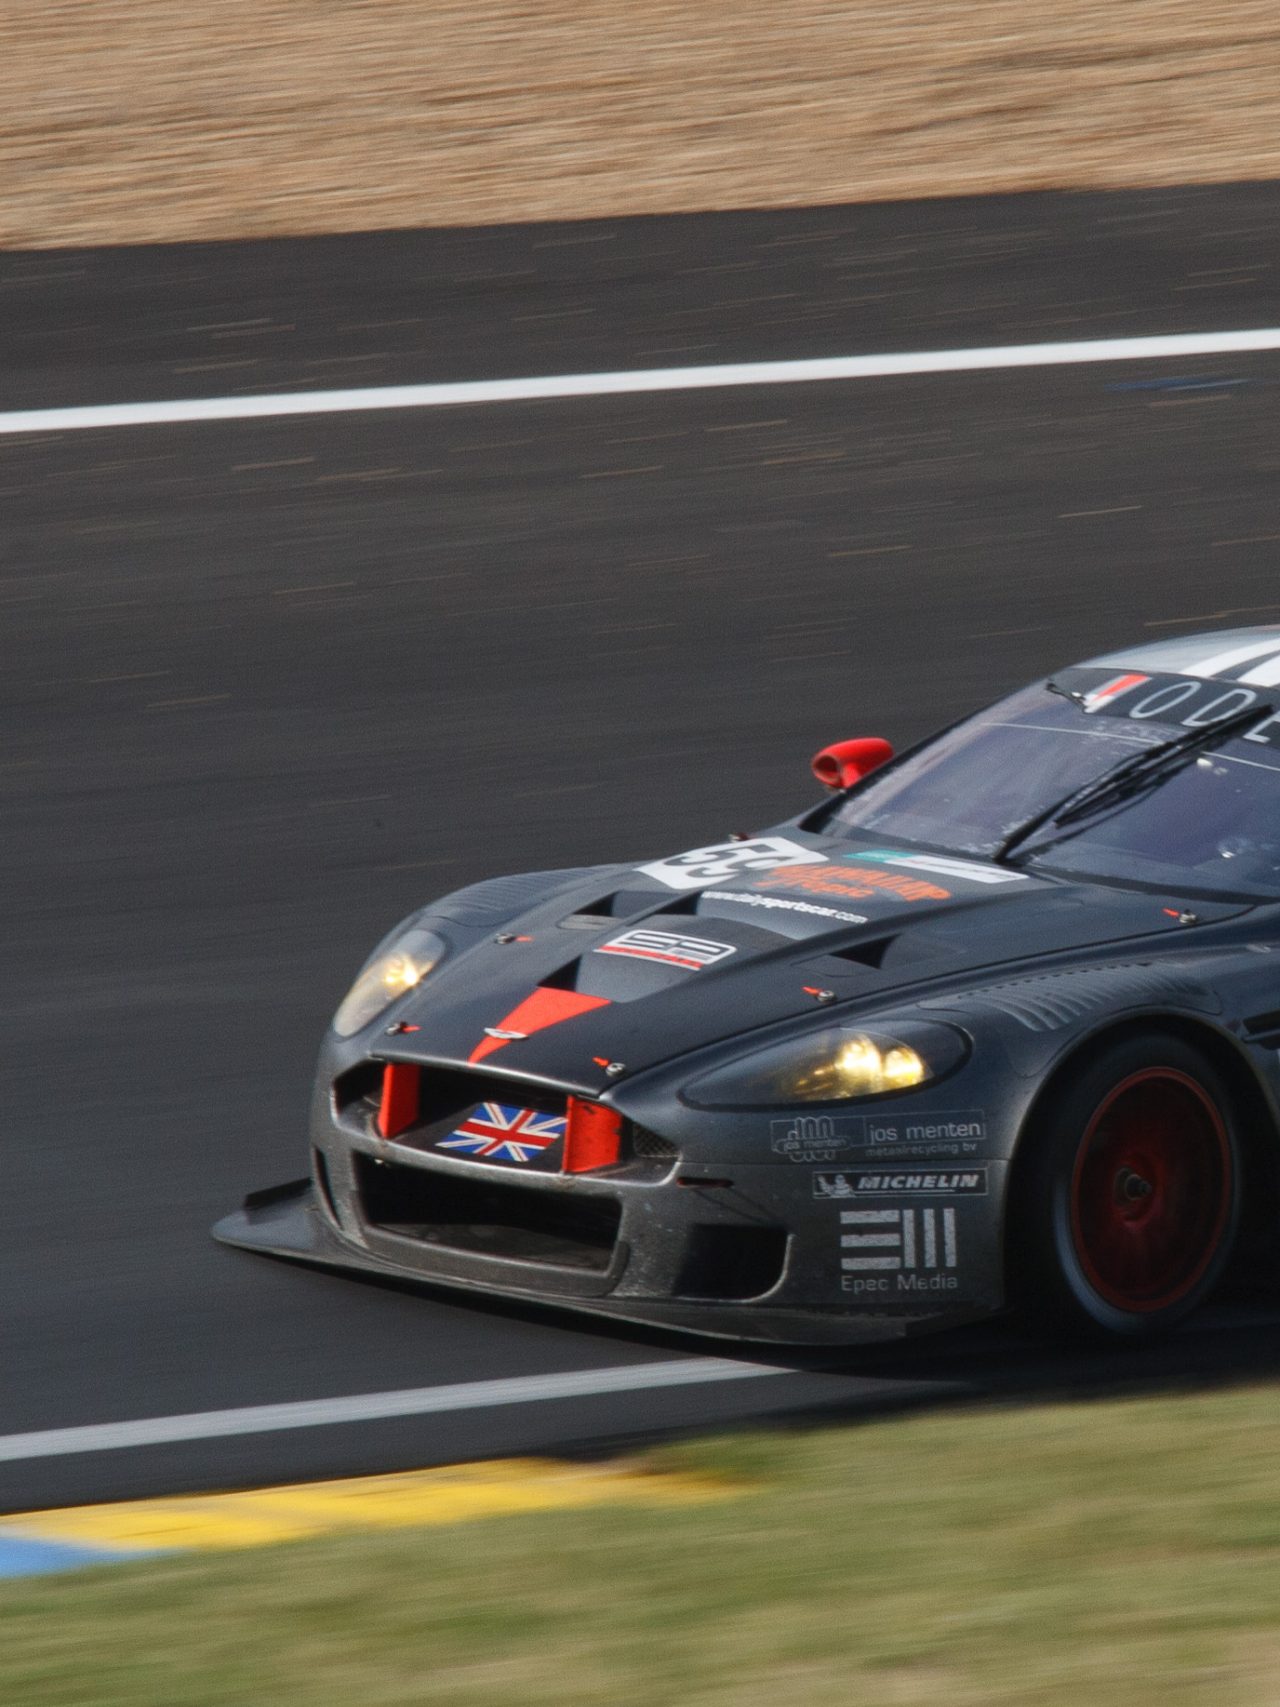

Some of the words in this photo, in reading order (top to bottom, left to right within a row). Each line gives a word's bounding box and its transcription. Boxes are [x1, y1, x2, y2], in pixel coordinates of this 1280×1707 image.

[869, 1124, 898, 1145] jos
[906, 1122, 981, 1141] menten
[857, 1173, 980, 1190] MICHELIN
[841, 1275, 889, 1294] Epac
[897, 1274, 959, 1292] Media
